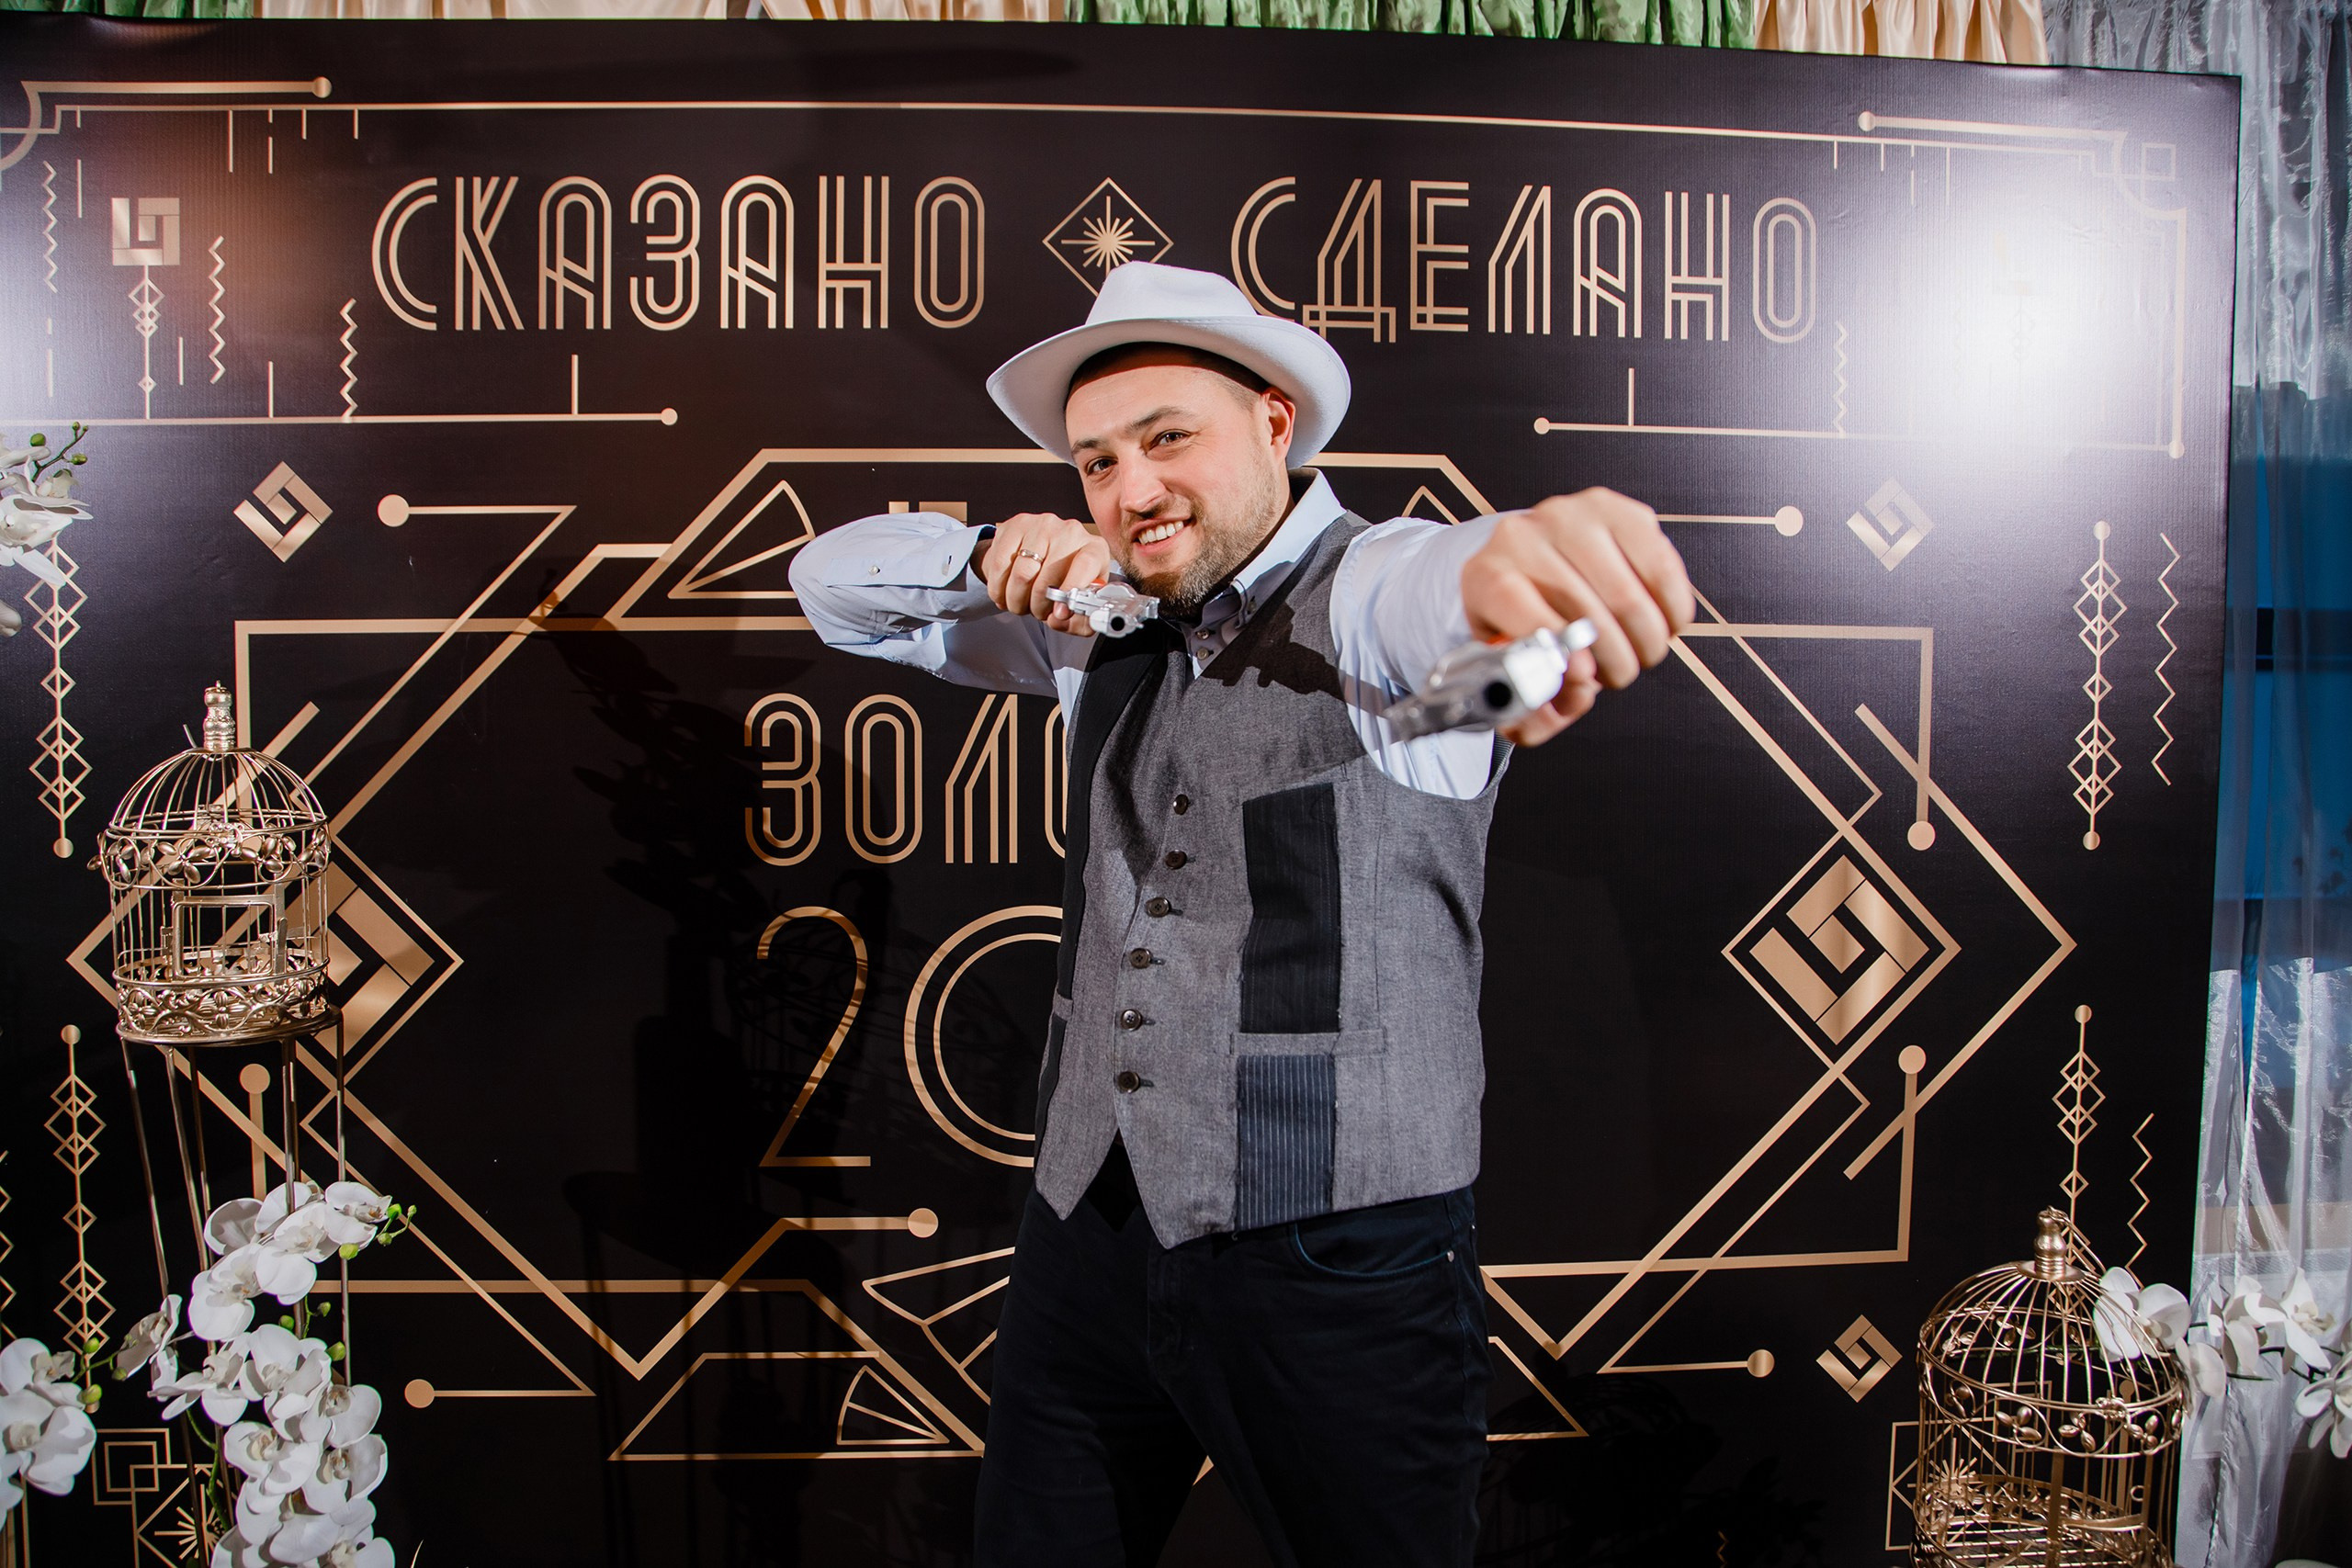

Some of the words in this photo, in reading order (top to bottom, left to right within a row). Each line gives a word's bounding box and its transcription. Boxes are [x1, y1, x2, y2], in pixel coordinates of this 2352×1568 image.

[371, 175, 986, 331] СКАЗАНО
[1230, 175, 1817, 344] СДЕЛАНО
[744, 693, 1068, 867] ЗОЛ
